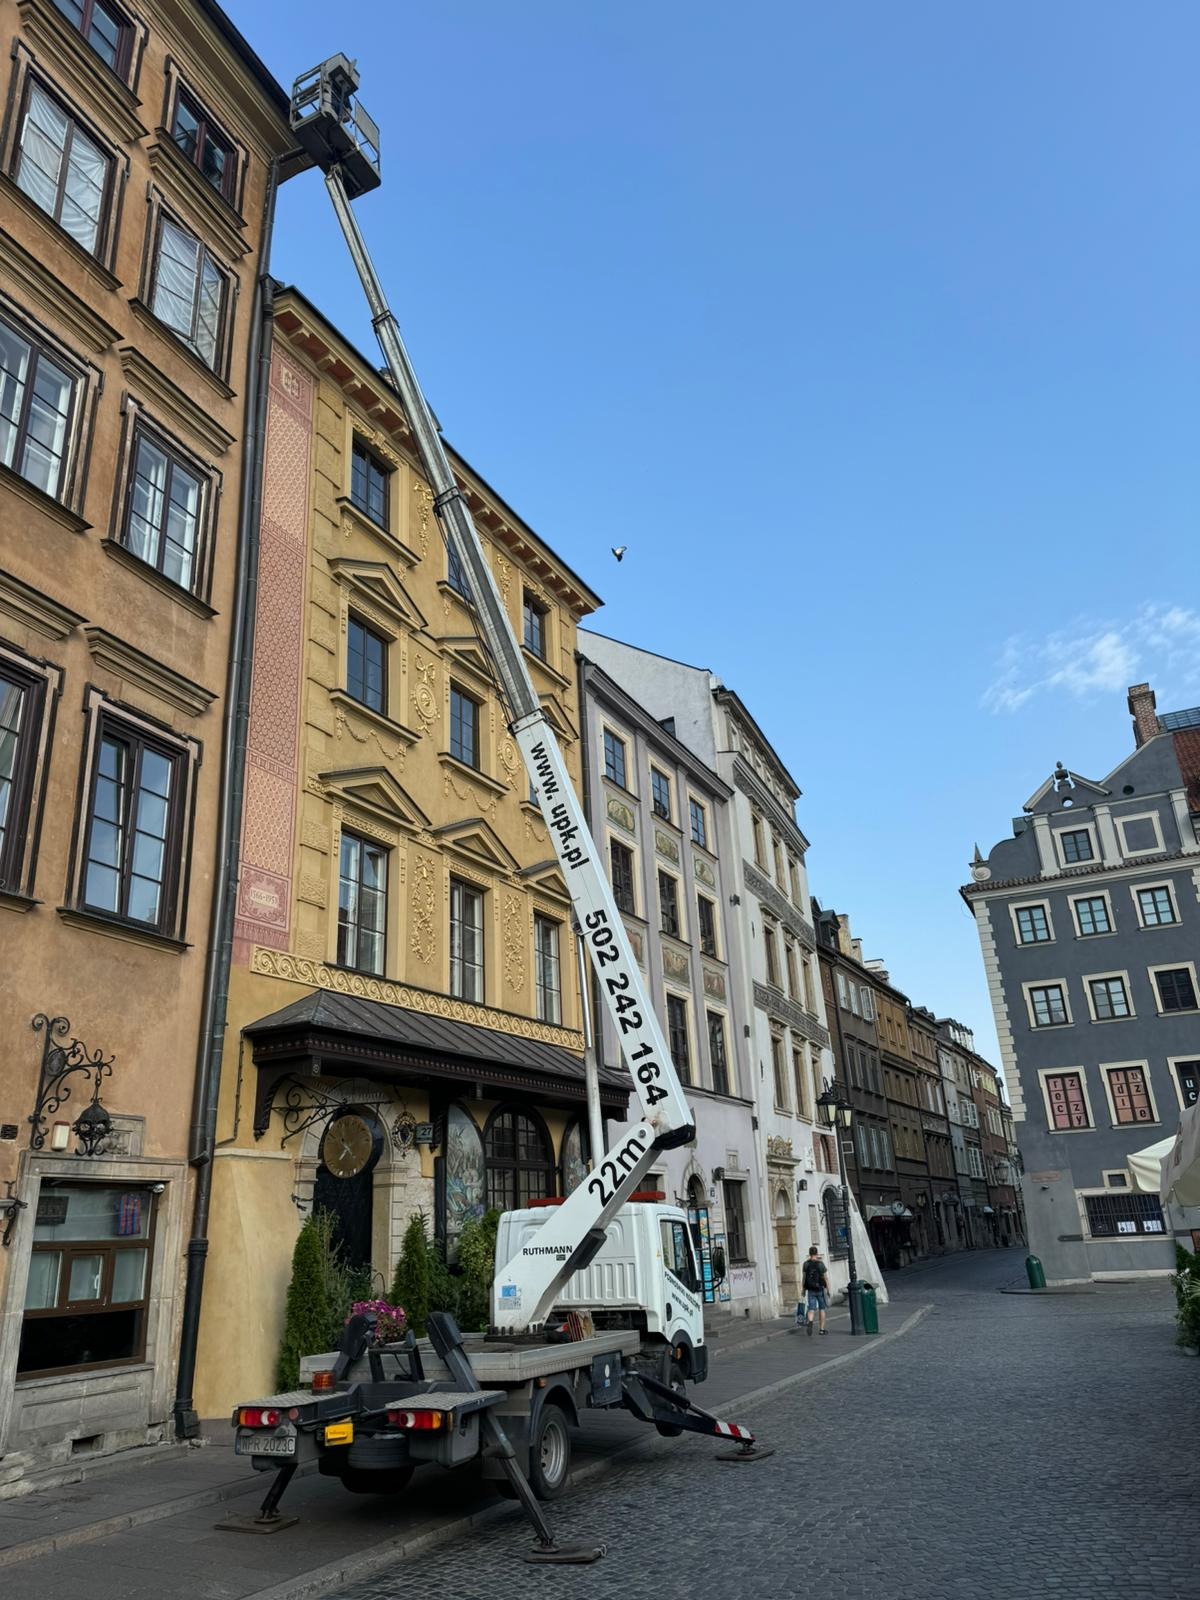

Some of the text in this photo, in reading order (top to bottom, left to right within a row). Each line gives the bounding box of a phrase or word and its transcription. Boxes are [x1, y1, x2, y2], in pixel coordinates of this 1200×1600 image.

[585, 909, 669, 1106] 502 242 164
[421, 1127, 432, 1136] 27
[588, 1138, 646, 1207] 22m
[522, 1245, 573, 1256] RUTHMANN
